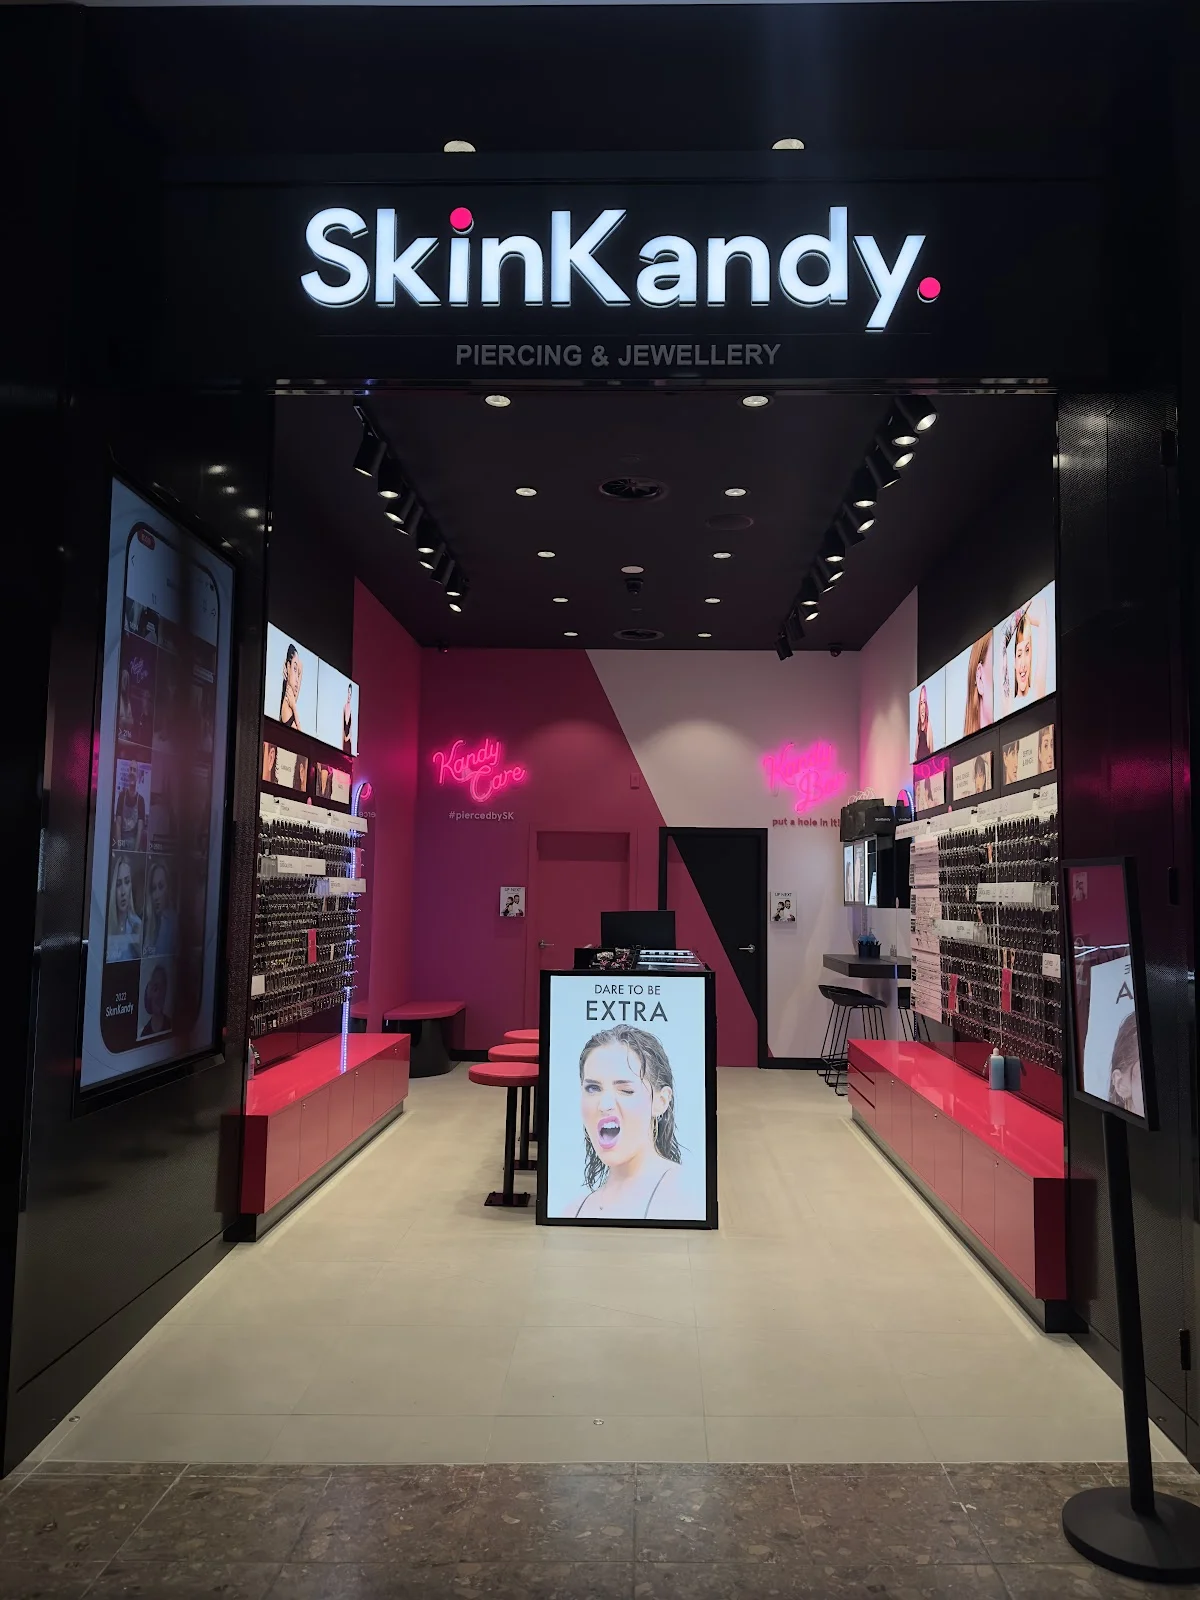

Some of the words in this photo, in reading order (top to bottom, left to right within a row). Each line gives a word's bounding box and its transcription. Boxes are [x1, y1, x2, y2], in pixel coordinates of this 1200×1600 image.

[300, 205, 942, 333] SkinKandy.
[456, 344, 582, 367] PIERCING
[591, 344, 610, 367] &
[618, 343, 781, 367] JEWELLERY
[432, 738, 501, 785] Kandy
[469, 764, 527, 802] Care
[448, 810, 514, 822] #piercedbySK
[772, 818, 788, 827] put
[797, 817, 818, 826] hole
[820, 818, 829, 826] in
[594, 984, 624, 995] DARE
[627, 984, 643, 995] TO
[647, 985, 661, 995] BE
[586, 1000, 668, 1022] EXTRA
